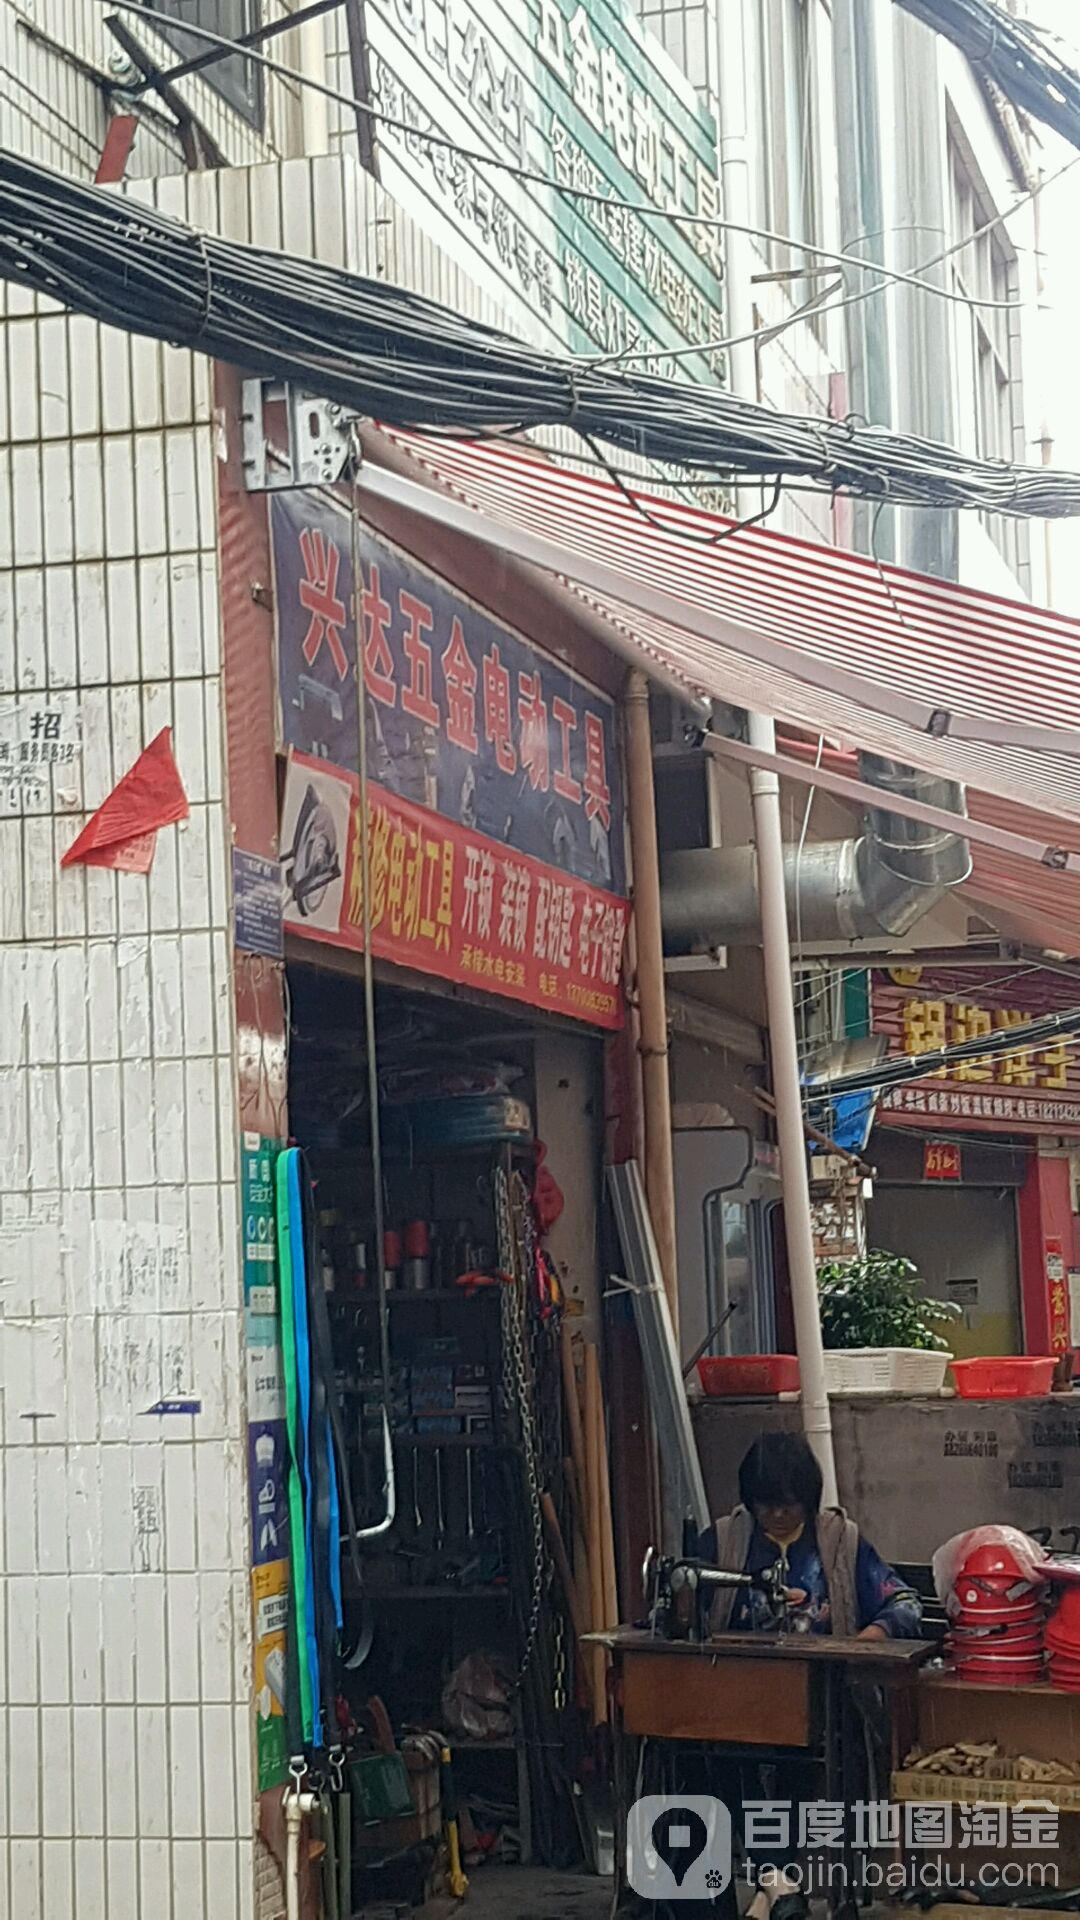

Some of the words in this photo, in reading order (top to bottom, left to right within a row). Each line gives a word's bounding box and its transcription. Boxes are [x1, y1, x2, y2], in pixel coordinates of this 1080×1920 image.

[30, 711, 62, 740] 招
[300, 527, 612, 830] 兴达五金电动工具
